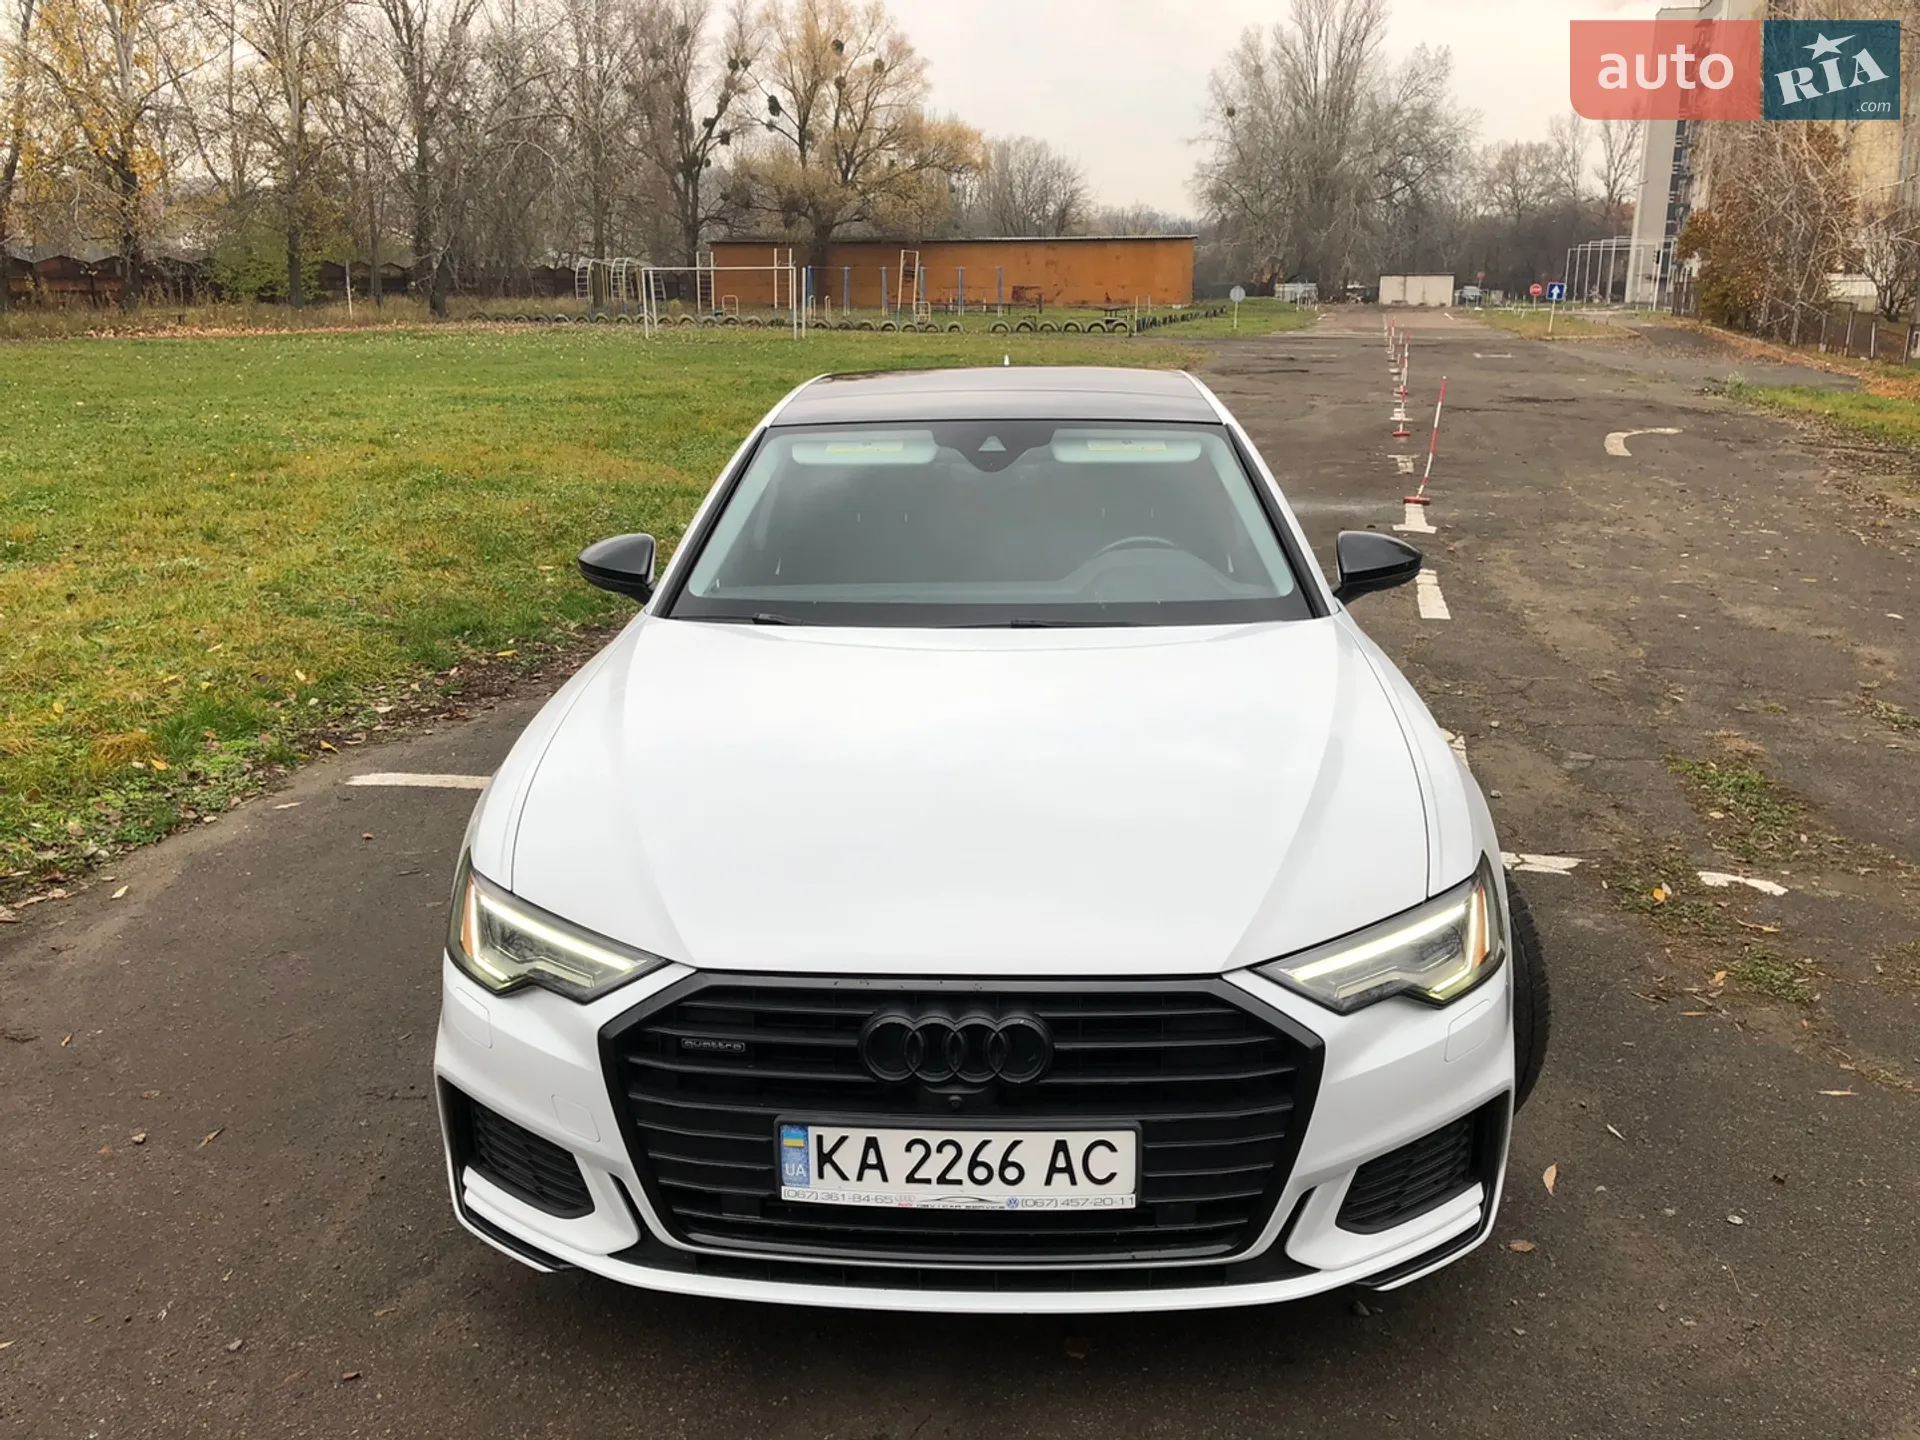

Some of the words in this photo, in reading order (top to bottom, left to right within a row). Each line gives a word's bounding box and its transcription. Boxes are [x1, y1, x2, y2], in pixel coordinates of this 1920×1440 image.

[785, 1163, 807, 1177] UA
[816, 1134, 889, 1183] KA
[904, 1138, 1026, 1186] 2266
[1044, 1139, 1118, 1187] AC
